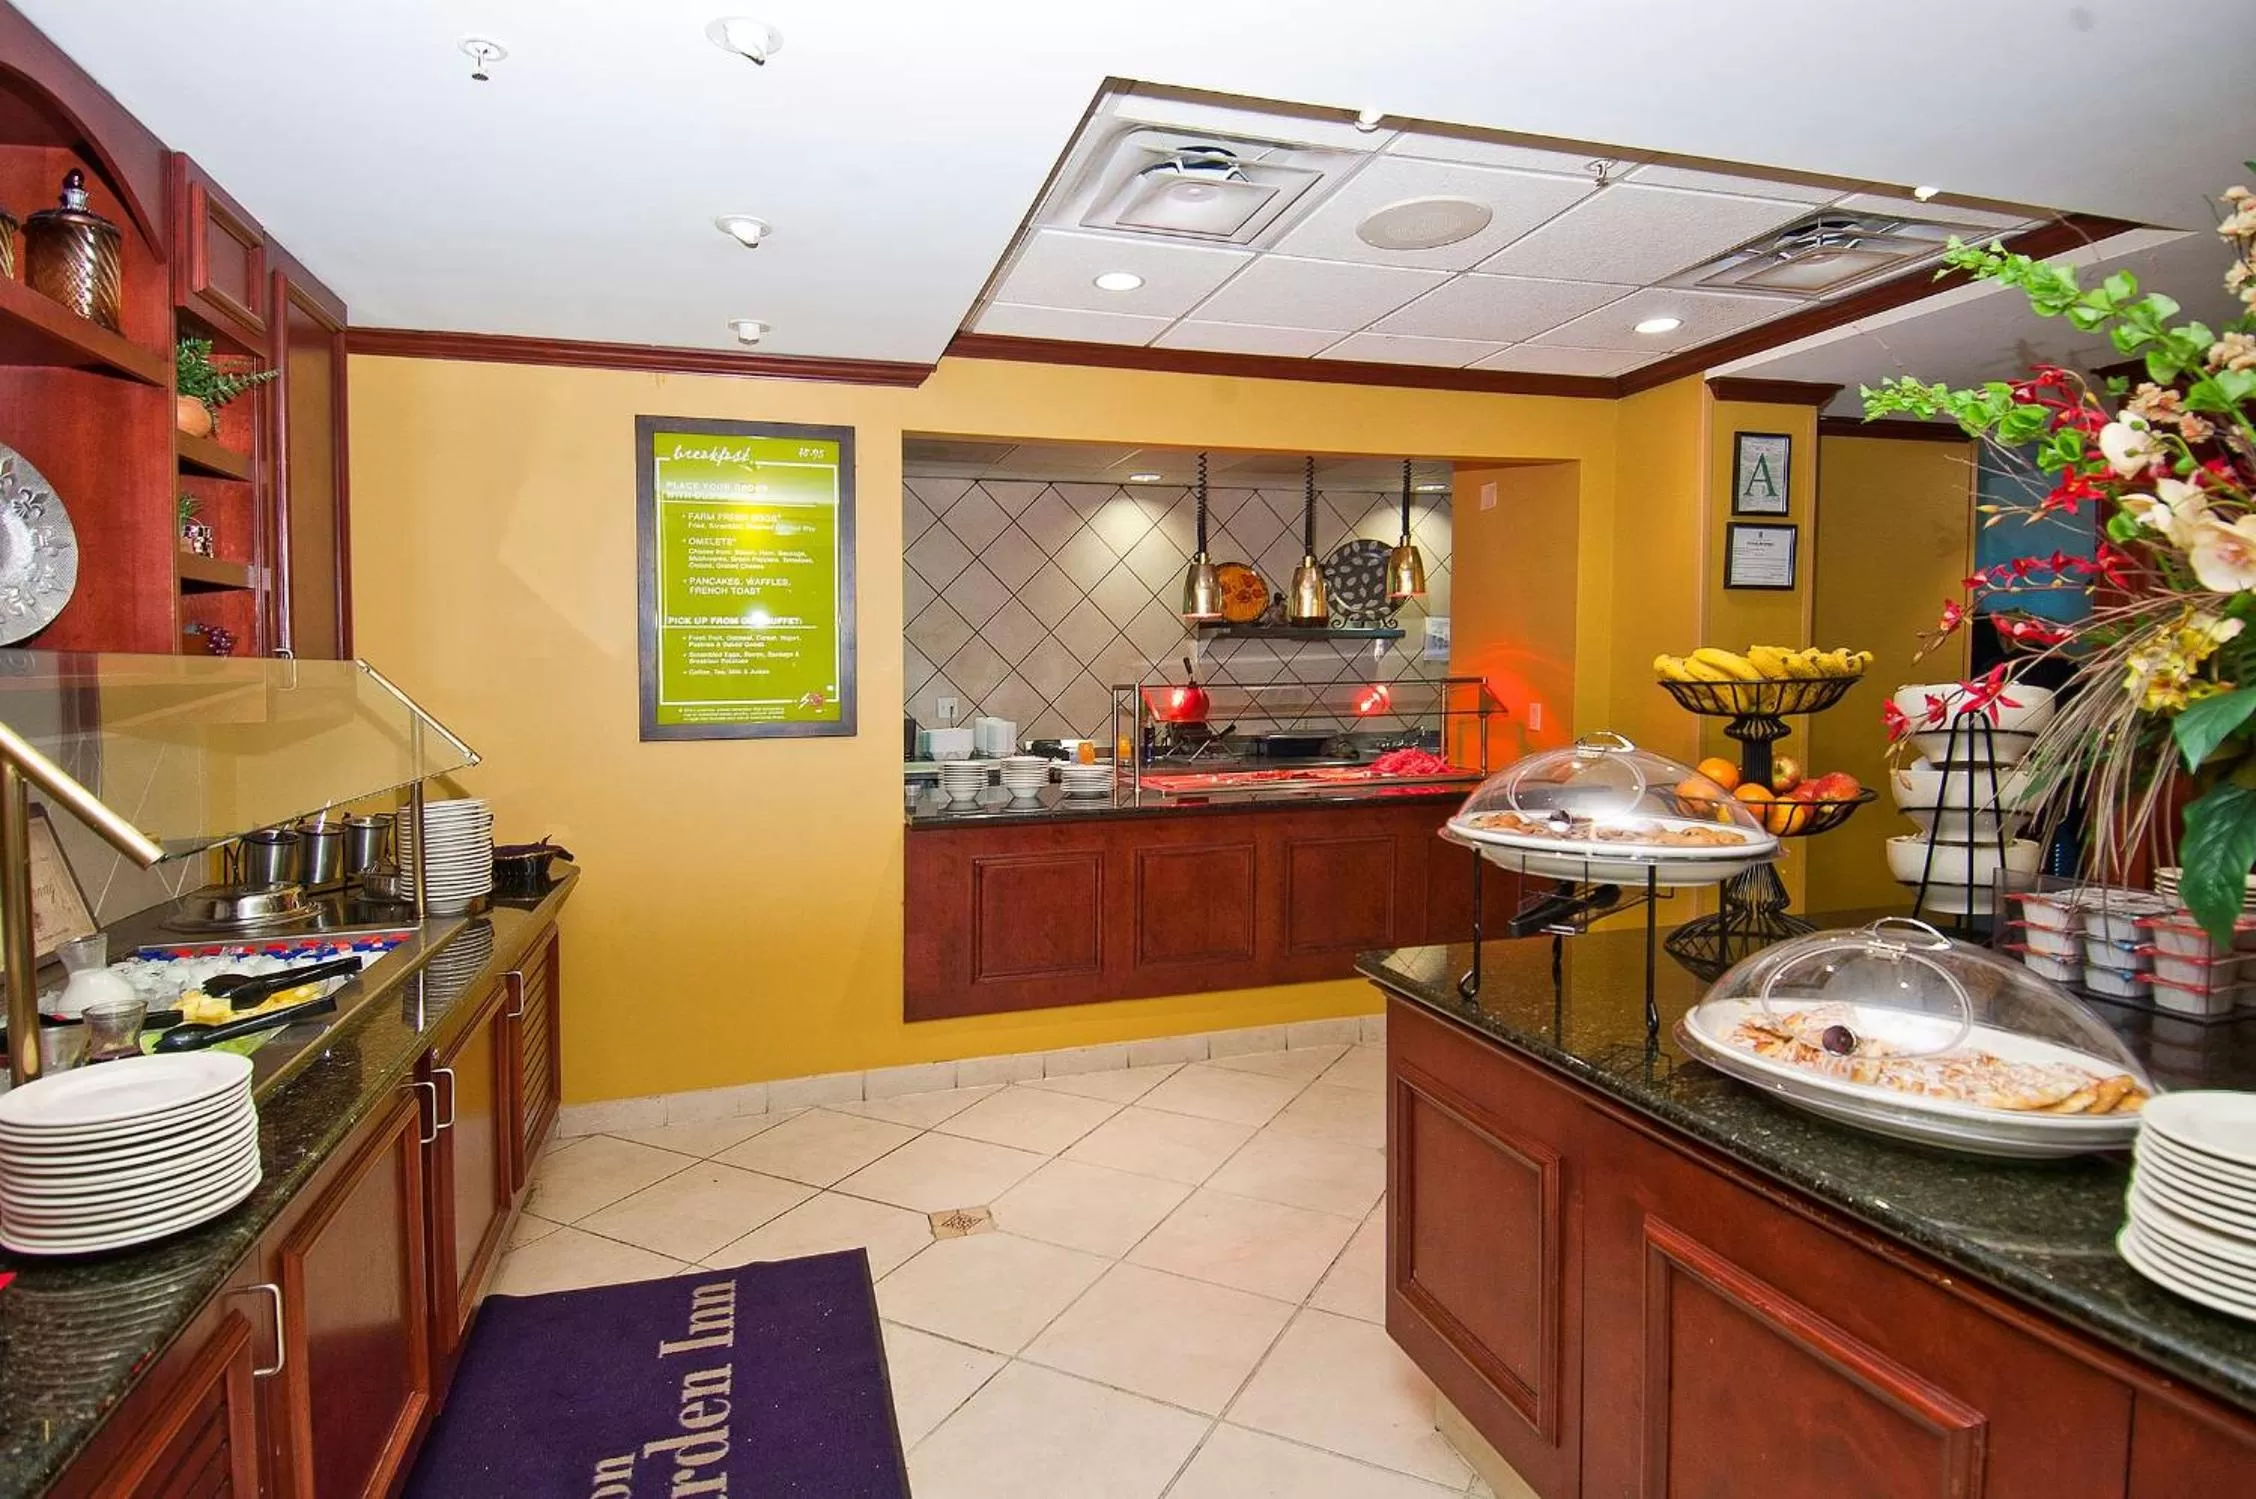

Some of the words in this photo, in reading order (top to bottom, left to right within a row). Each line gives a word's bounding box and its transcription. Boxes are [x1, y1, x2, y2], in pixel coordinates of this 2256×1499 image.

[673, 444, 751, 467] breakfast
[1743, 452, 1780, 497] A
[666, 481, 700, 490] PLACE
[703, 482, 730, 492] YOUR
[689, 512, 715, 520] FARM
[689, 586, 728, 595] FRENCH
[731, 587, 762, 596] TOAST
[668, 616, 691, 625] PICK
[694, 616, 708, 625] UP
[711, 616, 739, 625] FROM
[765, 616, 803, 625] UFFET:
[658, 1278, 738, 1359] Inn
